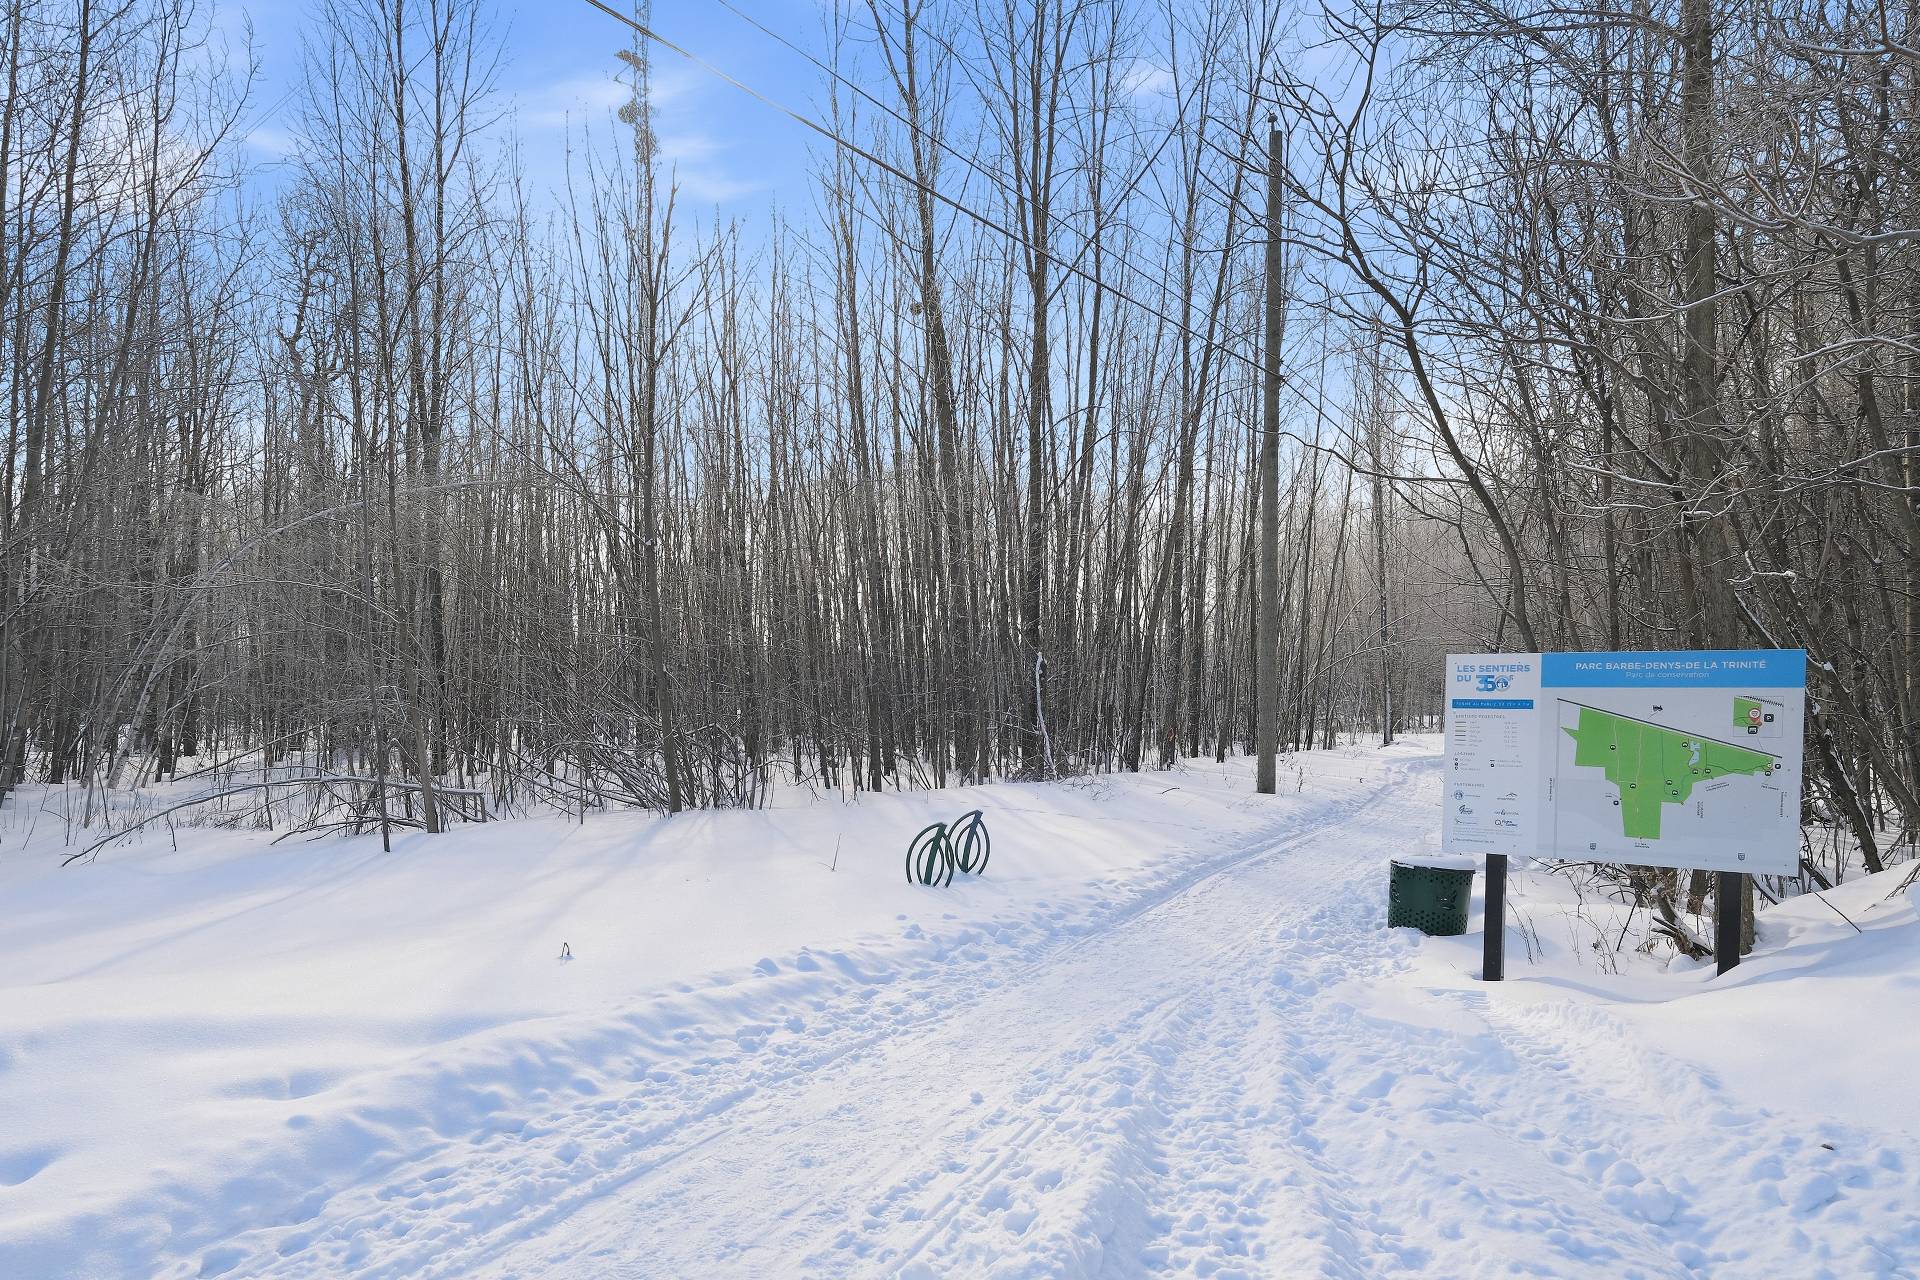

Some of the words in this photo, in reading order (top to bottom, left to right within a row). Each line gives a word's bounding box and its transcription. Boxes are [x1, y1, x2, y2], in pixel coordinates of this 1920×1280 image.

[1456, 664, 1476, 673] LES
[1478, 664, 1531, 672] SENTIERS
[1576, 662, 1602, 670] PARC
[1606, 661, 1700, 670] BARBE-DENYS-DE
[1704, 661, 1718, 669] LA
[1721, 659, 1767, 669] TRINITÉ
[1456, 674, 1472, 682] DU
[1626, 671, 1643, 679] Parc
[1657, 671, 1710, 679] conservation
